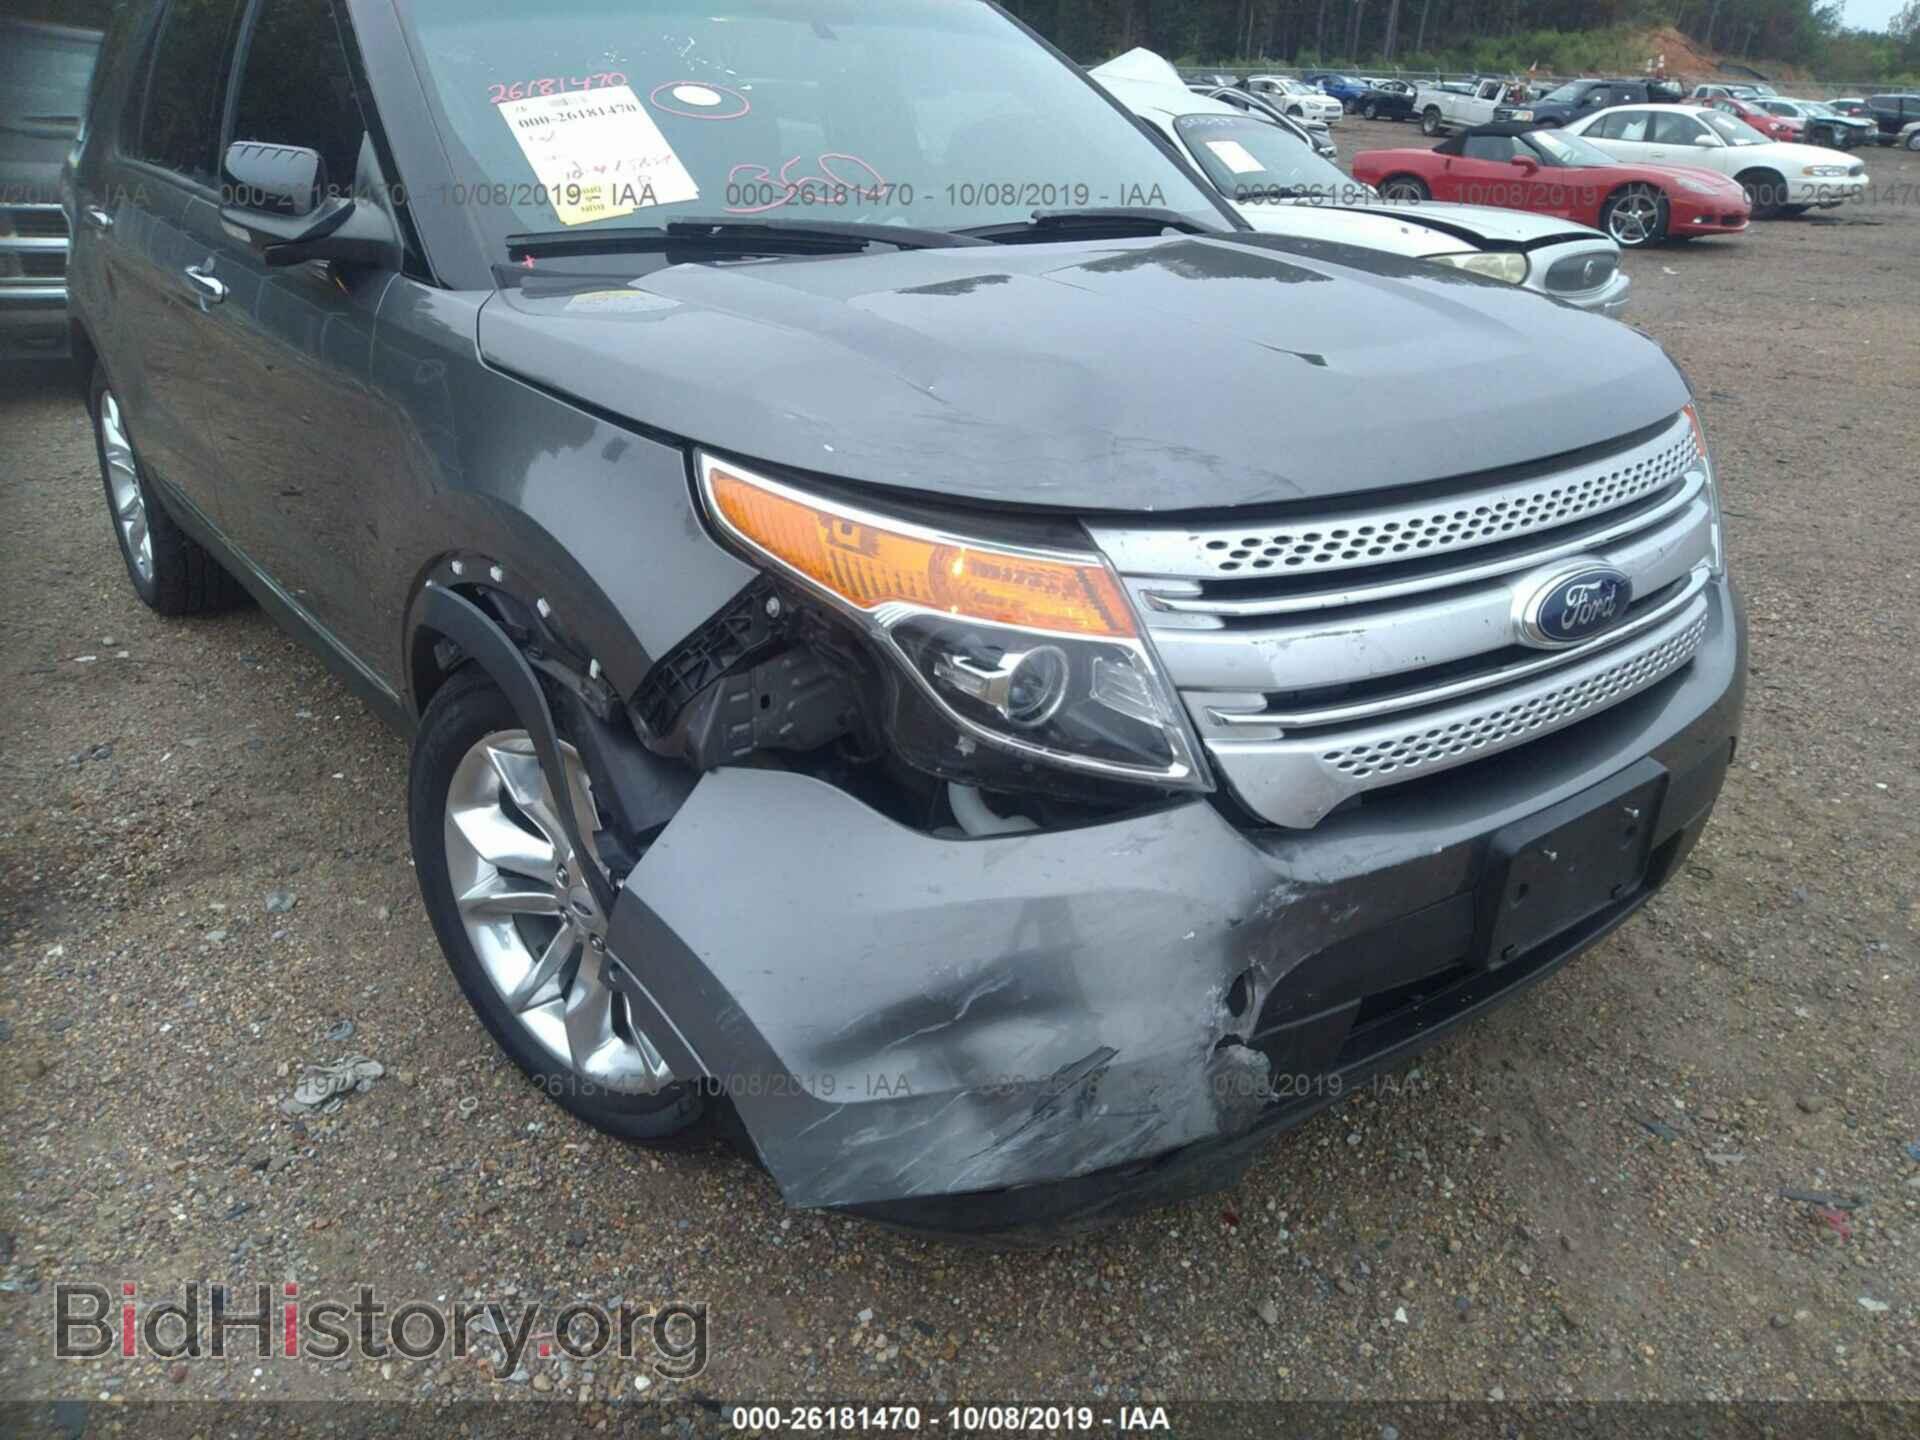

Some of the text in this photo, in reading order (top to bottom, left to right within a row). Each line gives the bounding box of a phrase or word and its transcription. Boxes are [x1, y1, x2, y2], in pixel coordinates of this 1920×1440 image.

[488, 72, 628, 104] 26181470
[518, 103, 638, 129] 000-26181470
[1561, 579, 1616, 630] Ford
